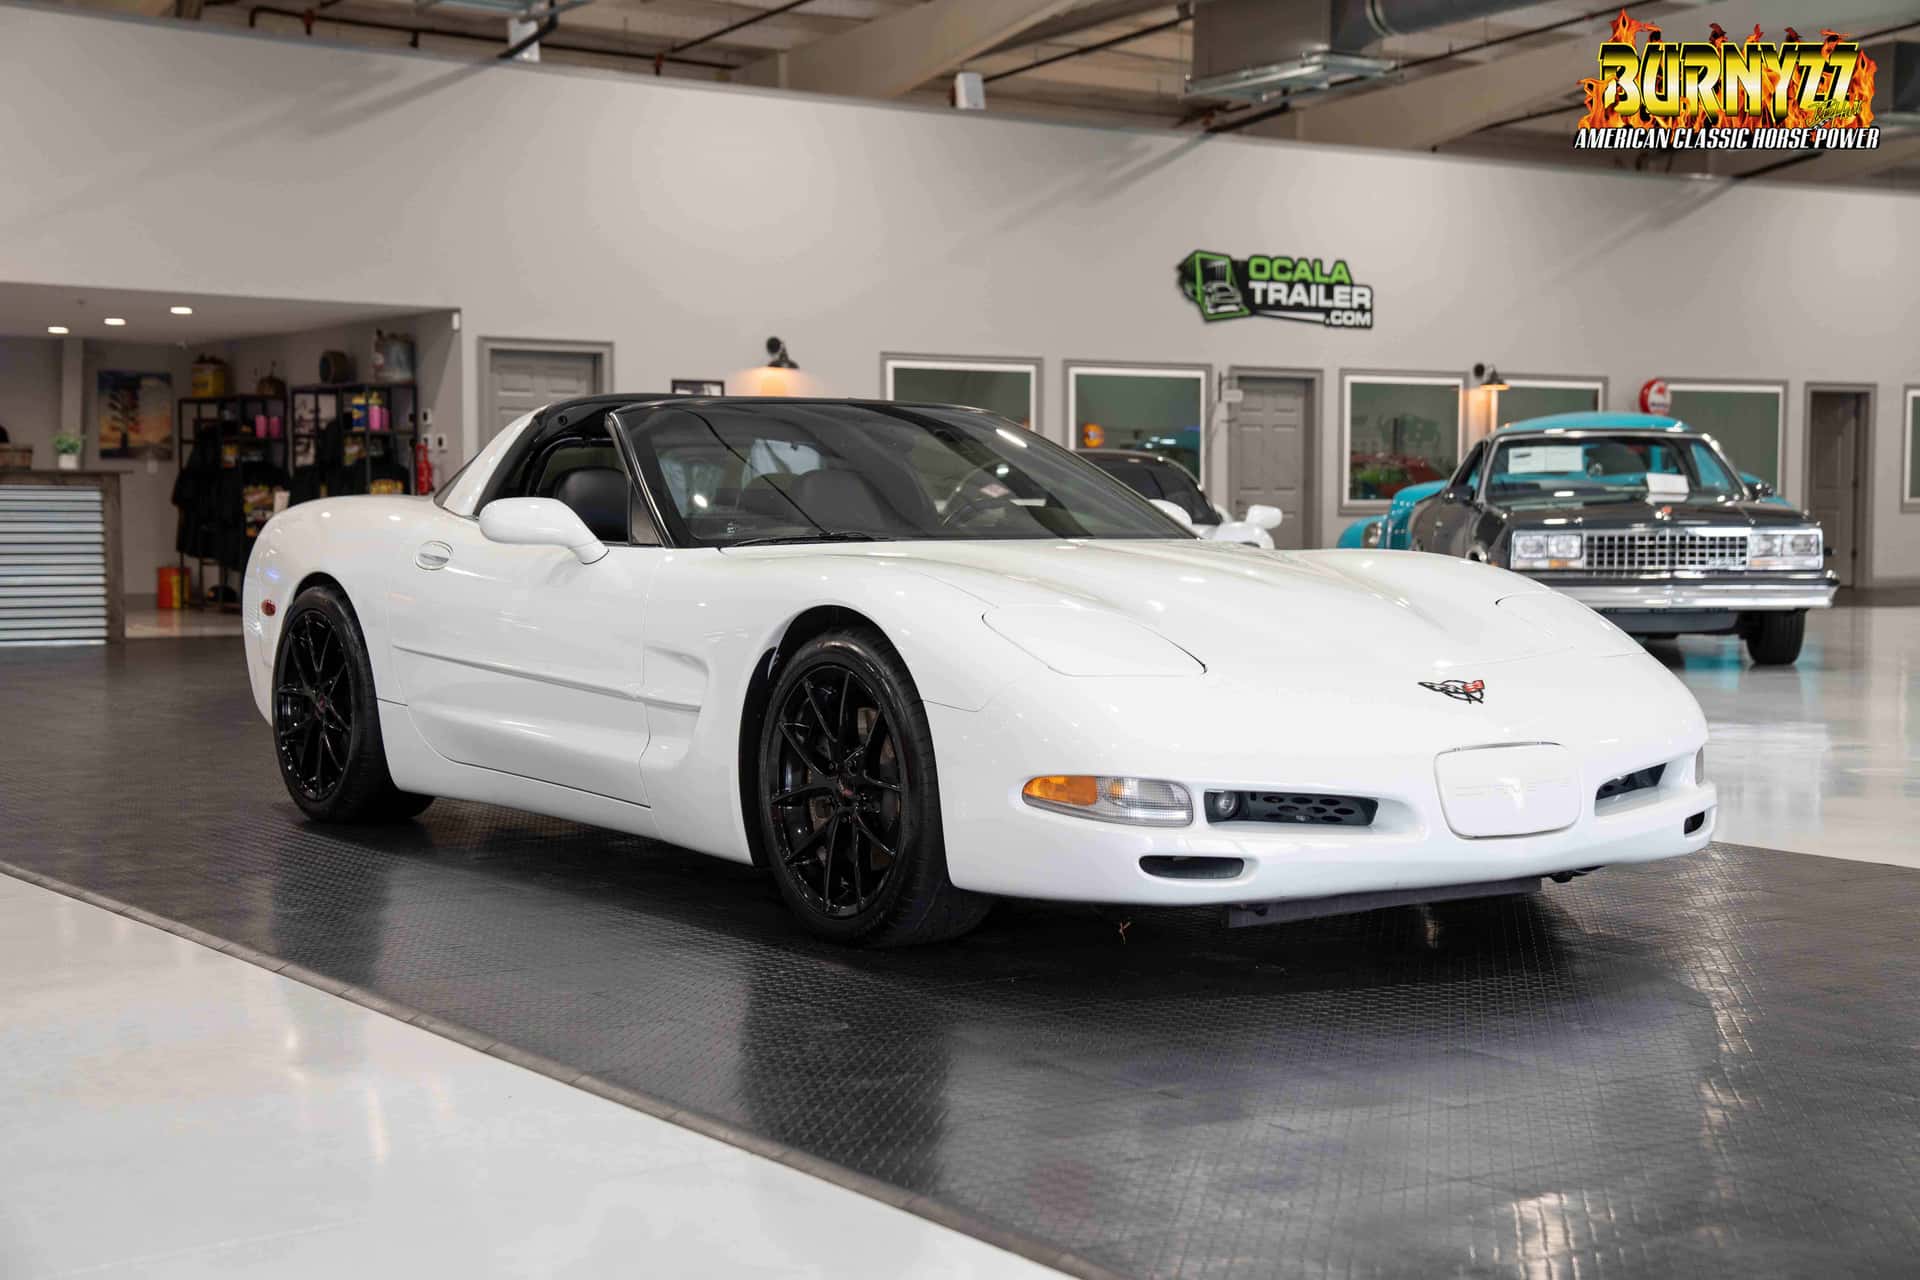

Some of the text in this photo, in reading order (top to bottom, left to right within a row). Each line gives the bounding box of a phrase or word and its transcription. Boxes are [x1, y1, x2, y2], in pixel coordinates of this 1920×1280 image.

[1249, 255, 1351, 284] OCALA
[1249, 281, 1371, 309] TRAILER
[1325, 311, 1371, 327] .COM
